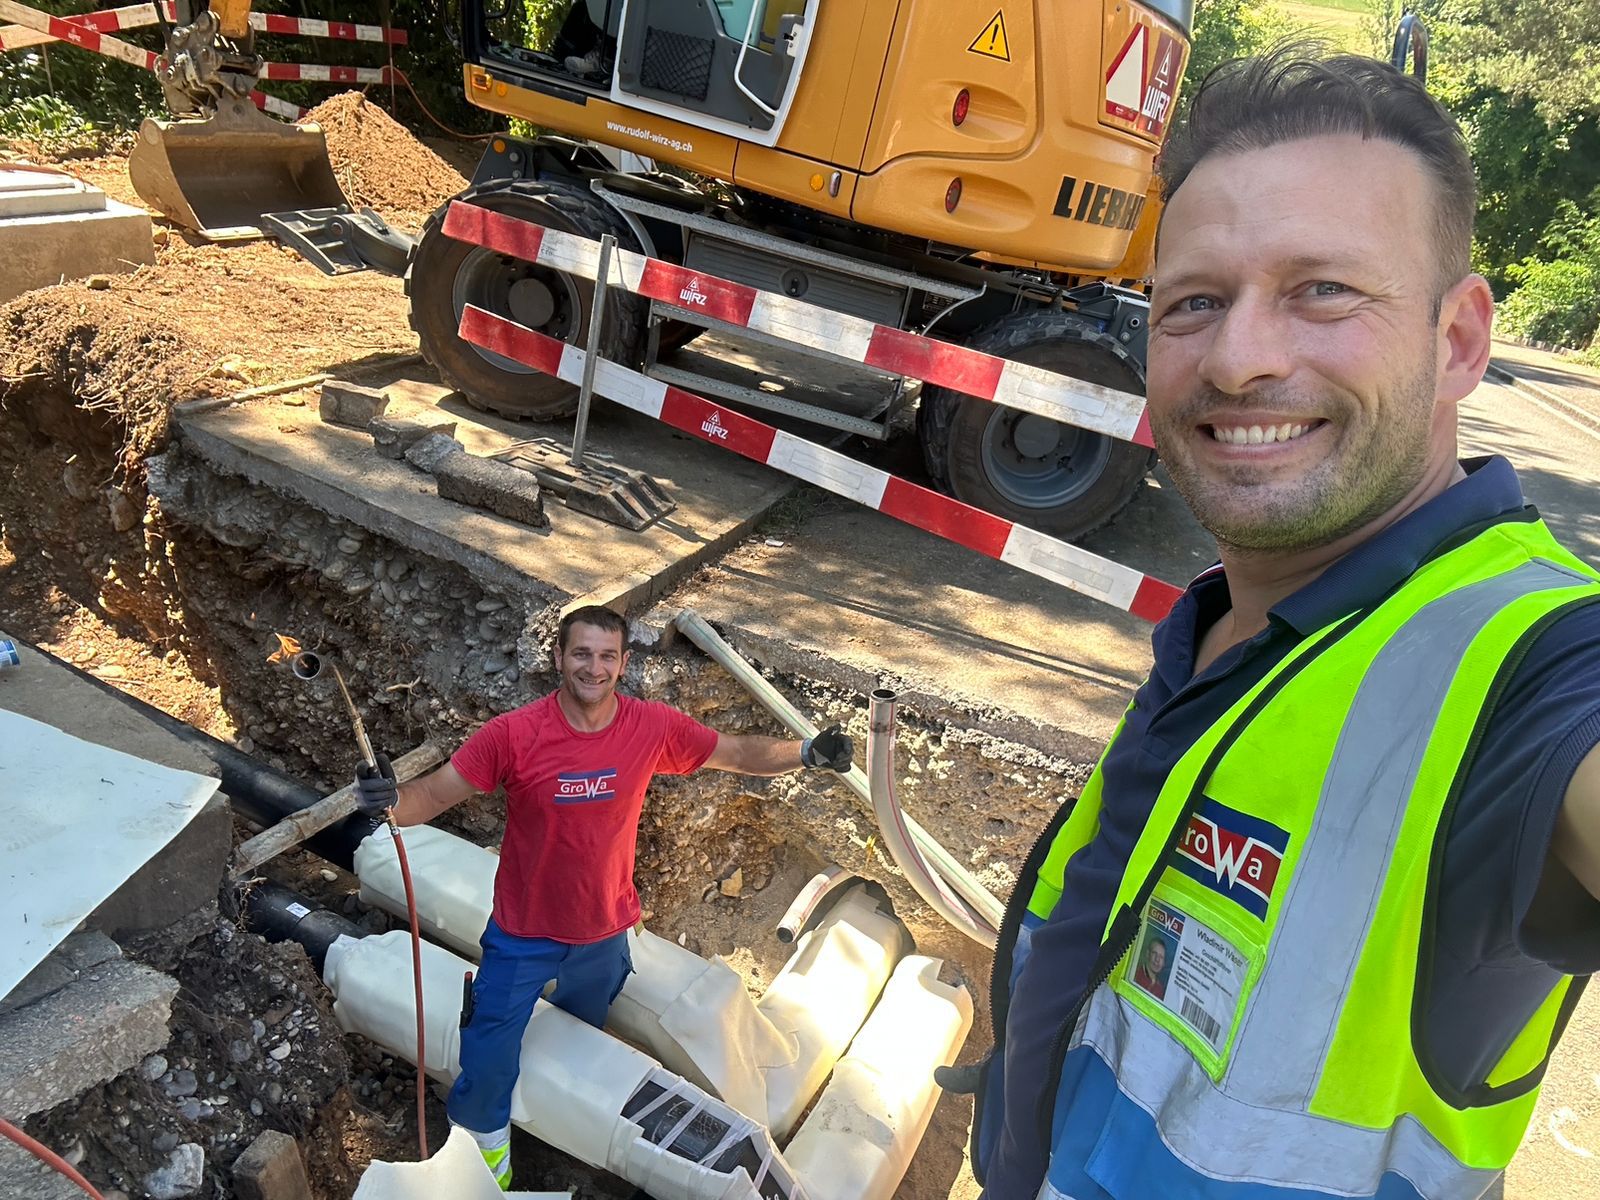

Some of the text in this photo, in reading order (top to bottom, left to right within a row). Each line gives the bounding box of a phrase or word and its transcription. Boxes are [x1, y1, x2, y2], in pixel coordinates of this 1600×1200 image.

[607, 121, 692, 152] www.rudolf-wirz-ag.ch
[680, 289, 707, 305] WIRZ
[701, 421, 728, 439] WIRZ
[560, 778, 607, 799] GroWa
[1181, 823, 1263, 890] roWa
[1151, 909, 1178, 931] GroWa
